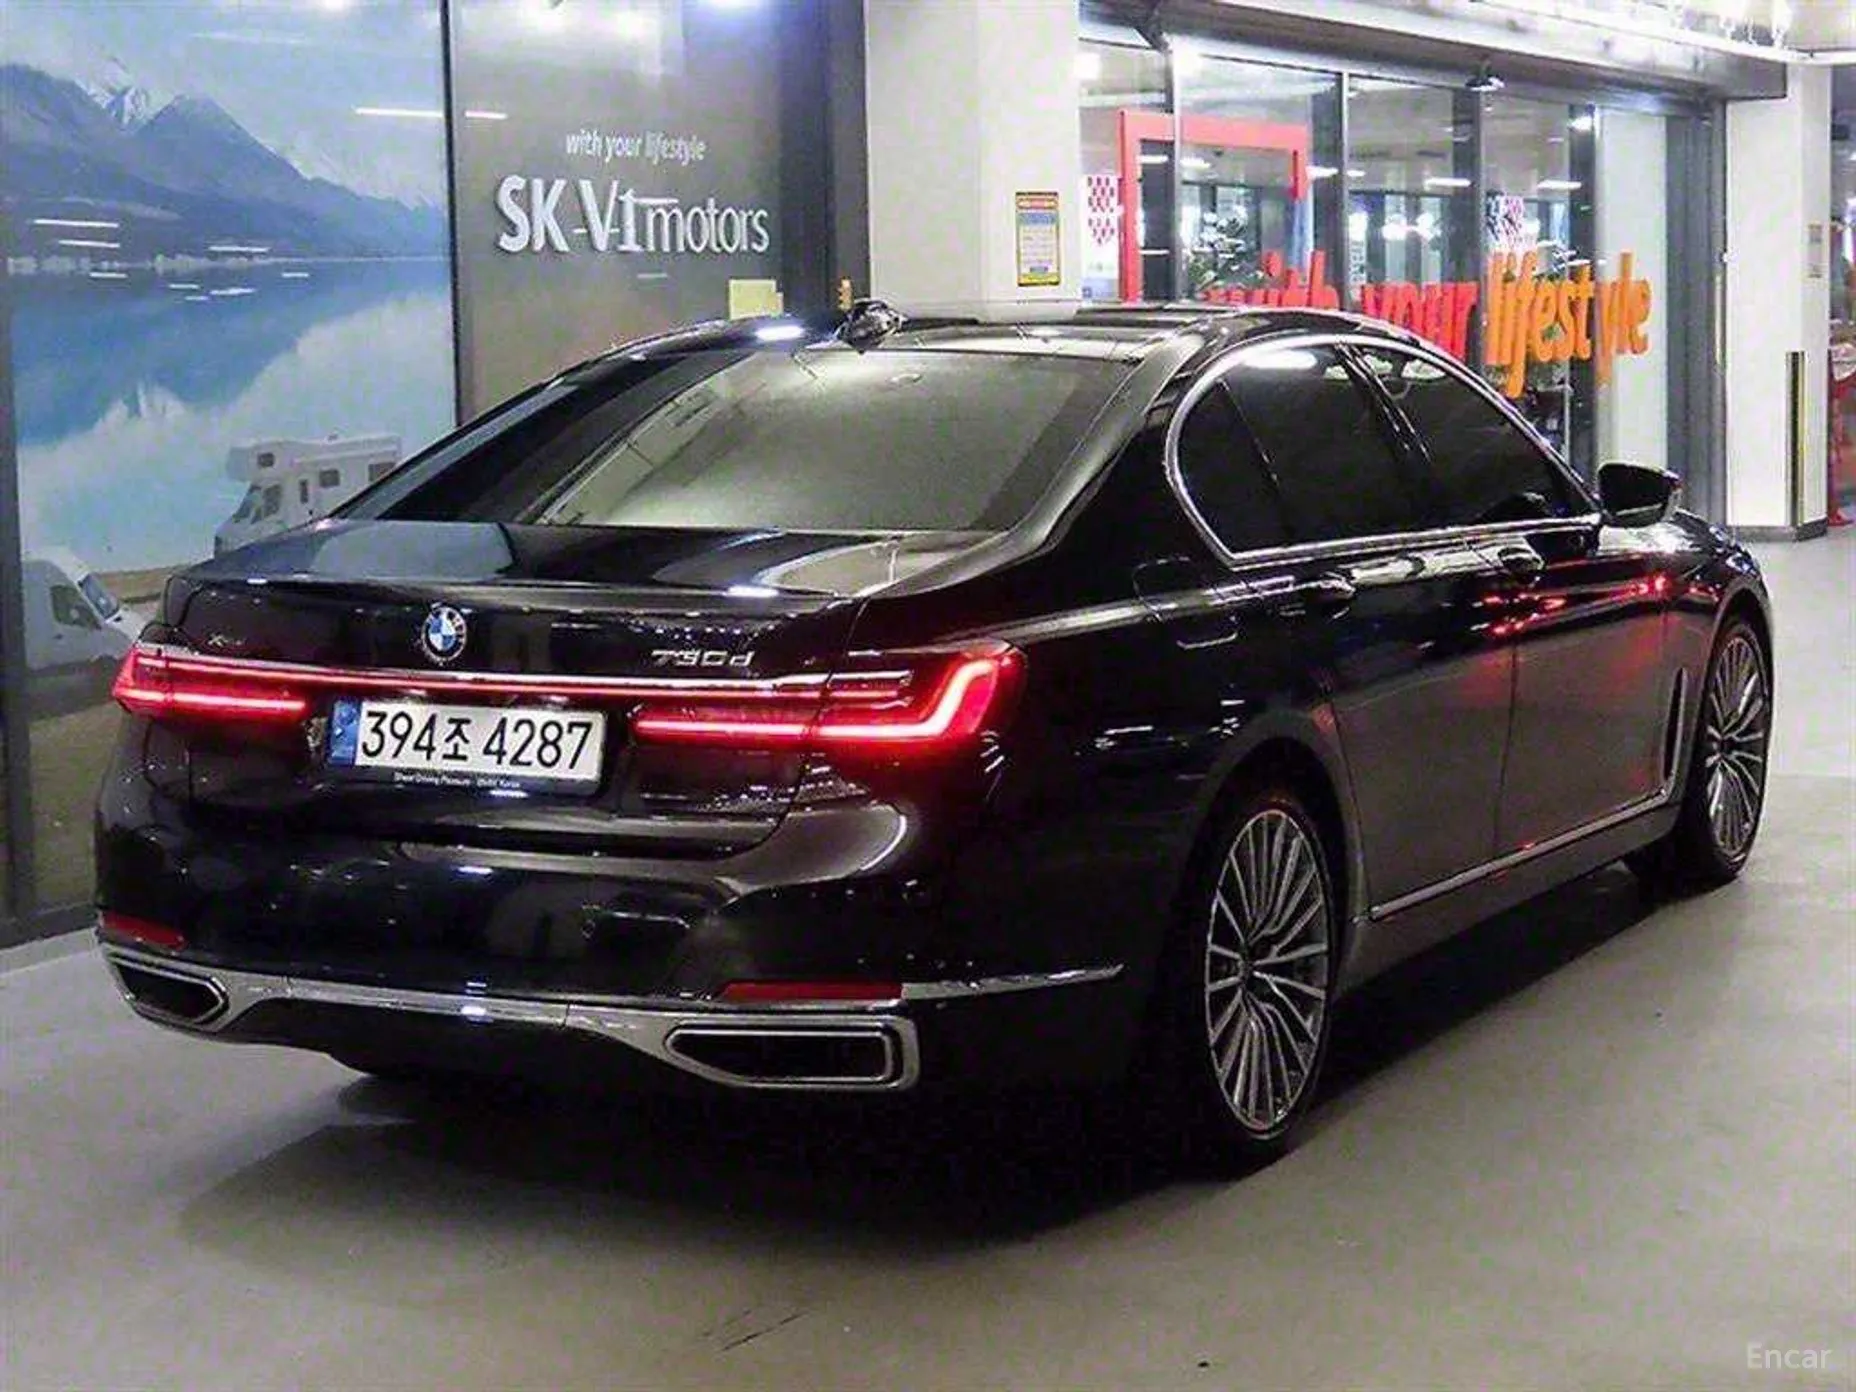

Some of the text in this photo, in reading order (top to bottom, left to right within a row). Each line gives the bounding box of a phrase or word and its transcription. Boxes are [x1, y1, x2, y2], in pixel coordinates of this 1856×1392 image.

[566, 129, 706, 166] with your lifestyle
[1486, 251, 1651, 398] lifestyle
[362, 710, 594, 770] 394조 4287
